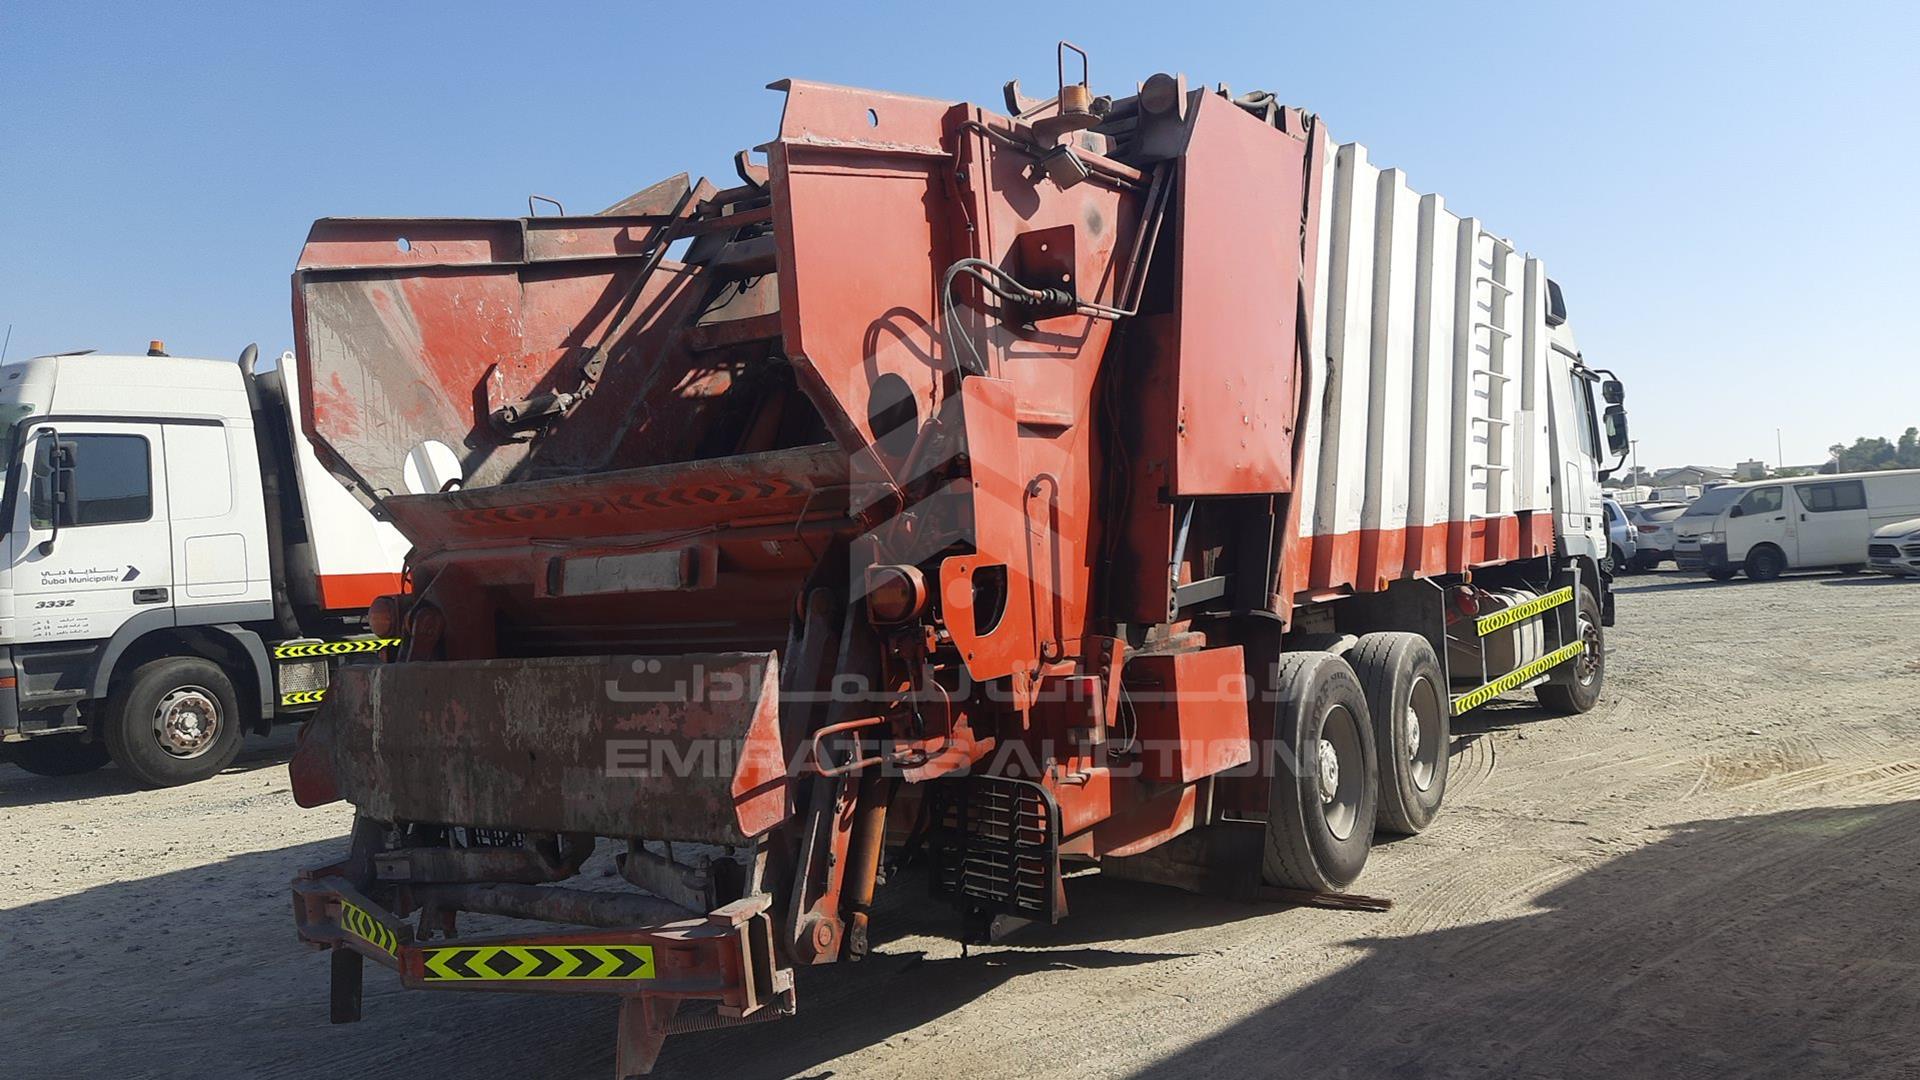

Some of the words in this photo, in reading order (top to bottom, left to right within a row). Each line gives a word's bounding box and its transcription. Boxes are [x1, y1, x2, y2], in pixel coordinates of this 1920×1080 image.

[41, 577, 67, 585] Dubai
[68, 575, 119, 584] Municipality
[34, 599, 76, 609] 3332
